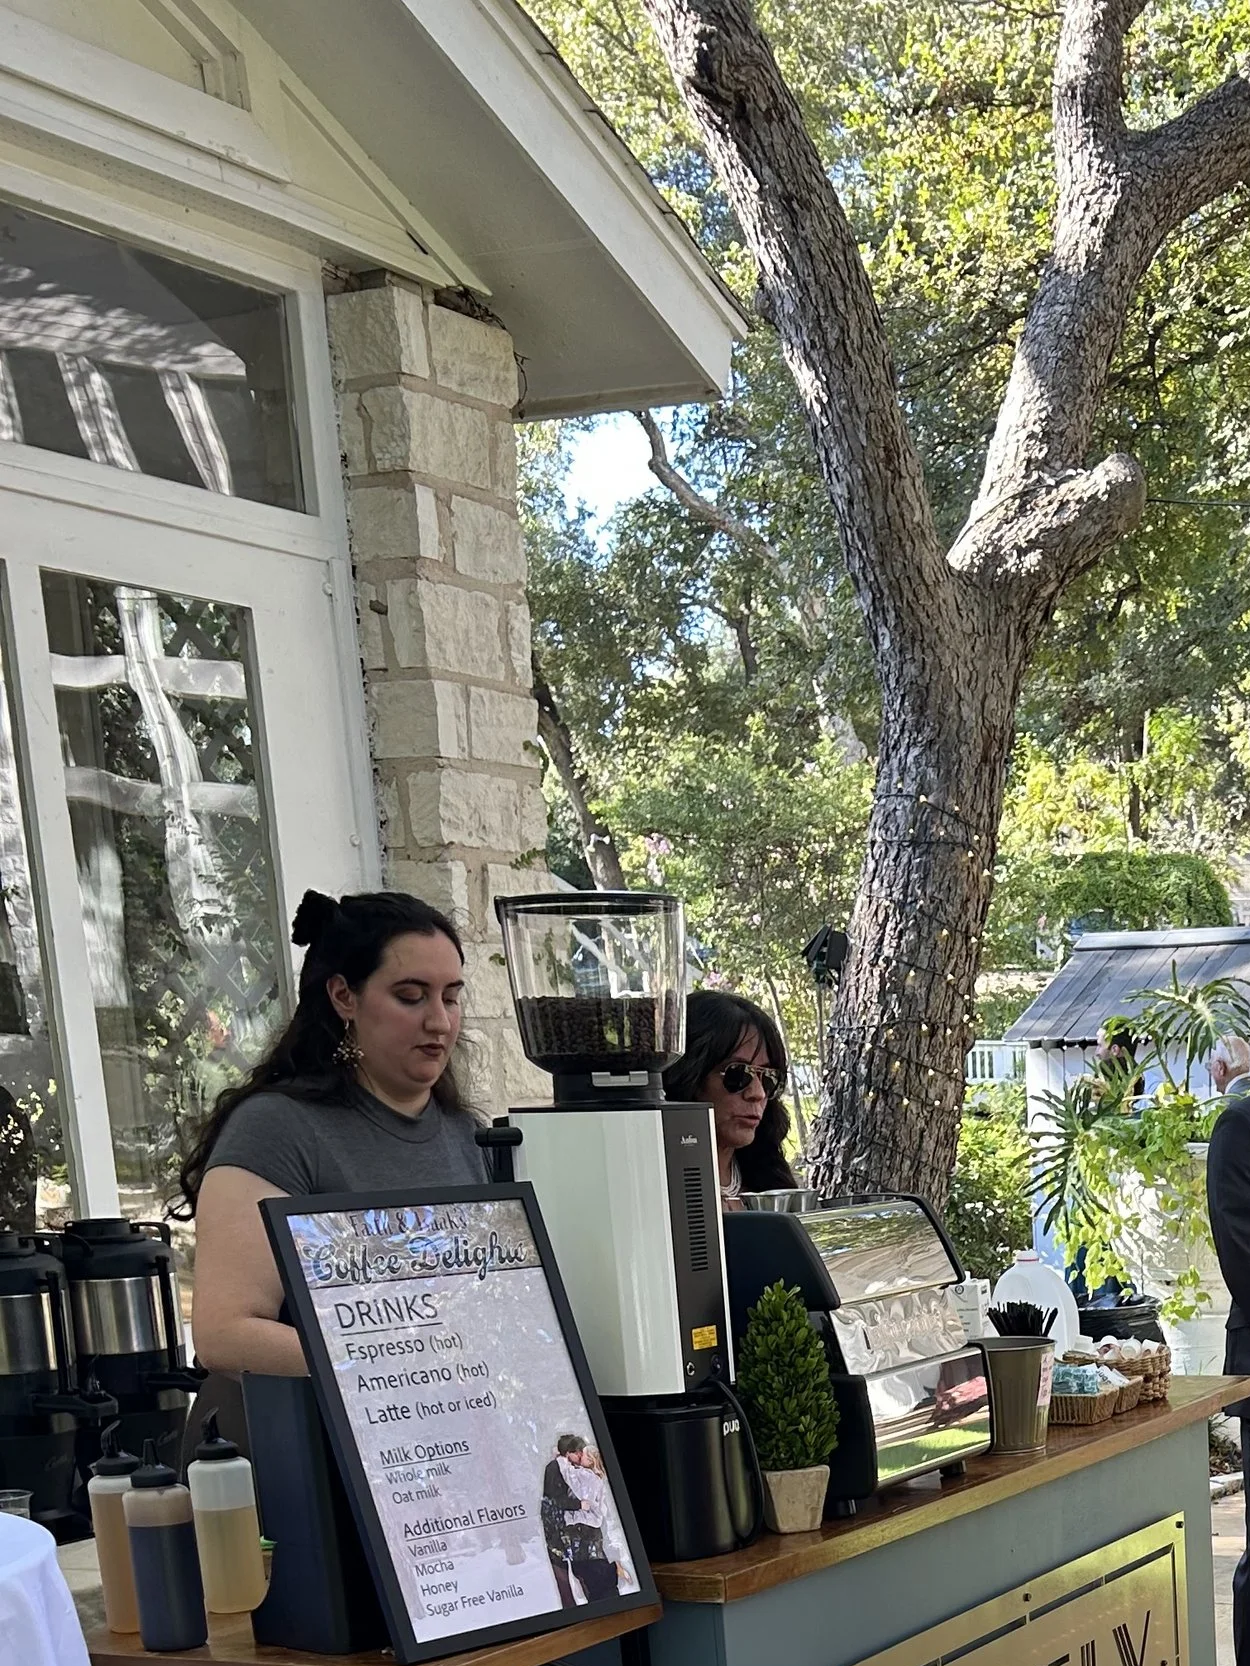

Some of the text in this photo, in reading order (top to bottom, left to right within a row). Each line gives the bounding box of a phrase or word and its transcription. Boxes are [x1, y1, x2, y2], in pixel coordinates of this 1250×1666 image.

[395, 1213, 409, 1233] &
[303, 1245, 401, 1284] Coffee
[345, 1332, 464, 1364] Espresso (hot)
[357, 1360, 490, 1393] Americano (hot)
[364, 1390, 497, 1425] Latte (hot or iced)
[380, 1440, 470, 1466] Milk Options
[385, 1462, 453, 1484] Whole milk
[392, 1484, 443, 1505] Oat milk
[404, 1504, 526, 1538] Additional Flavors
[407, 1540, 448, 1557] Vanilla
[415, 1559, 455, 1577] Mocha
[420, 1581, 458, 1597] Honey
[426, 1584, 524, 1618] Sugar Free Vanilla
